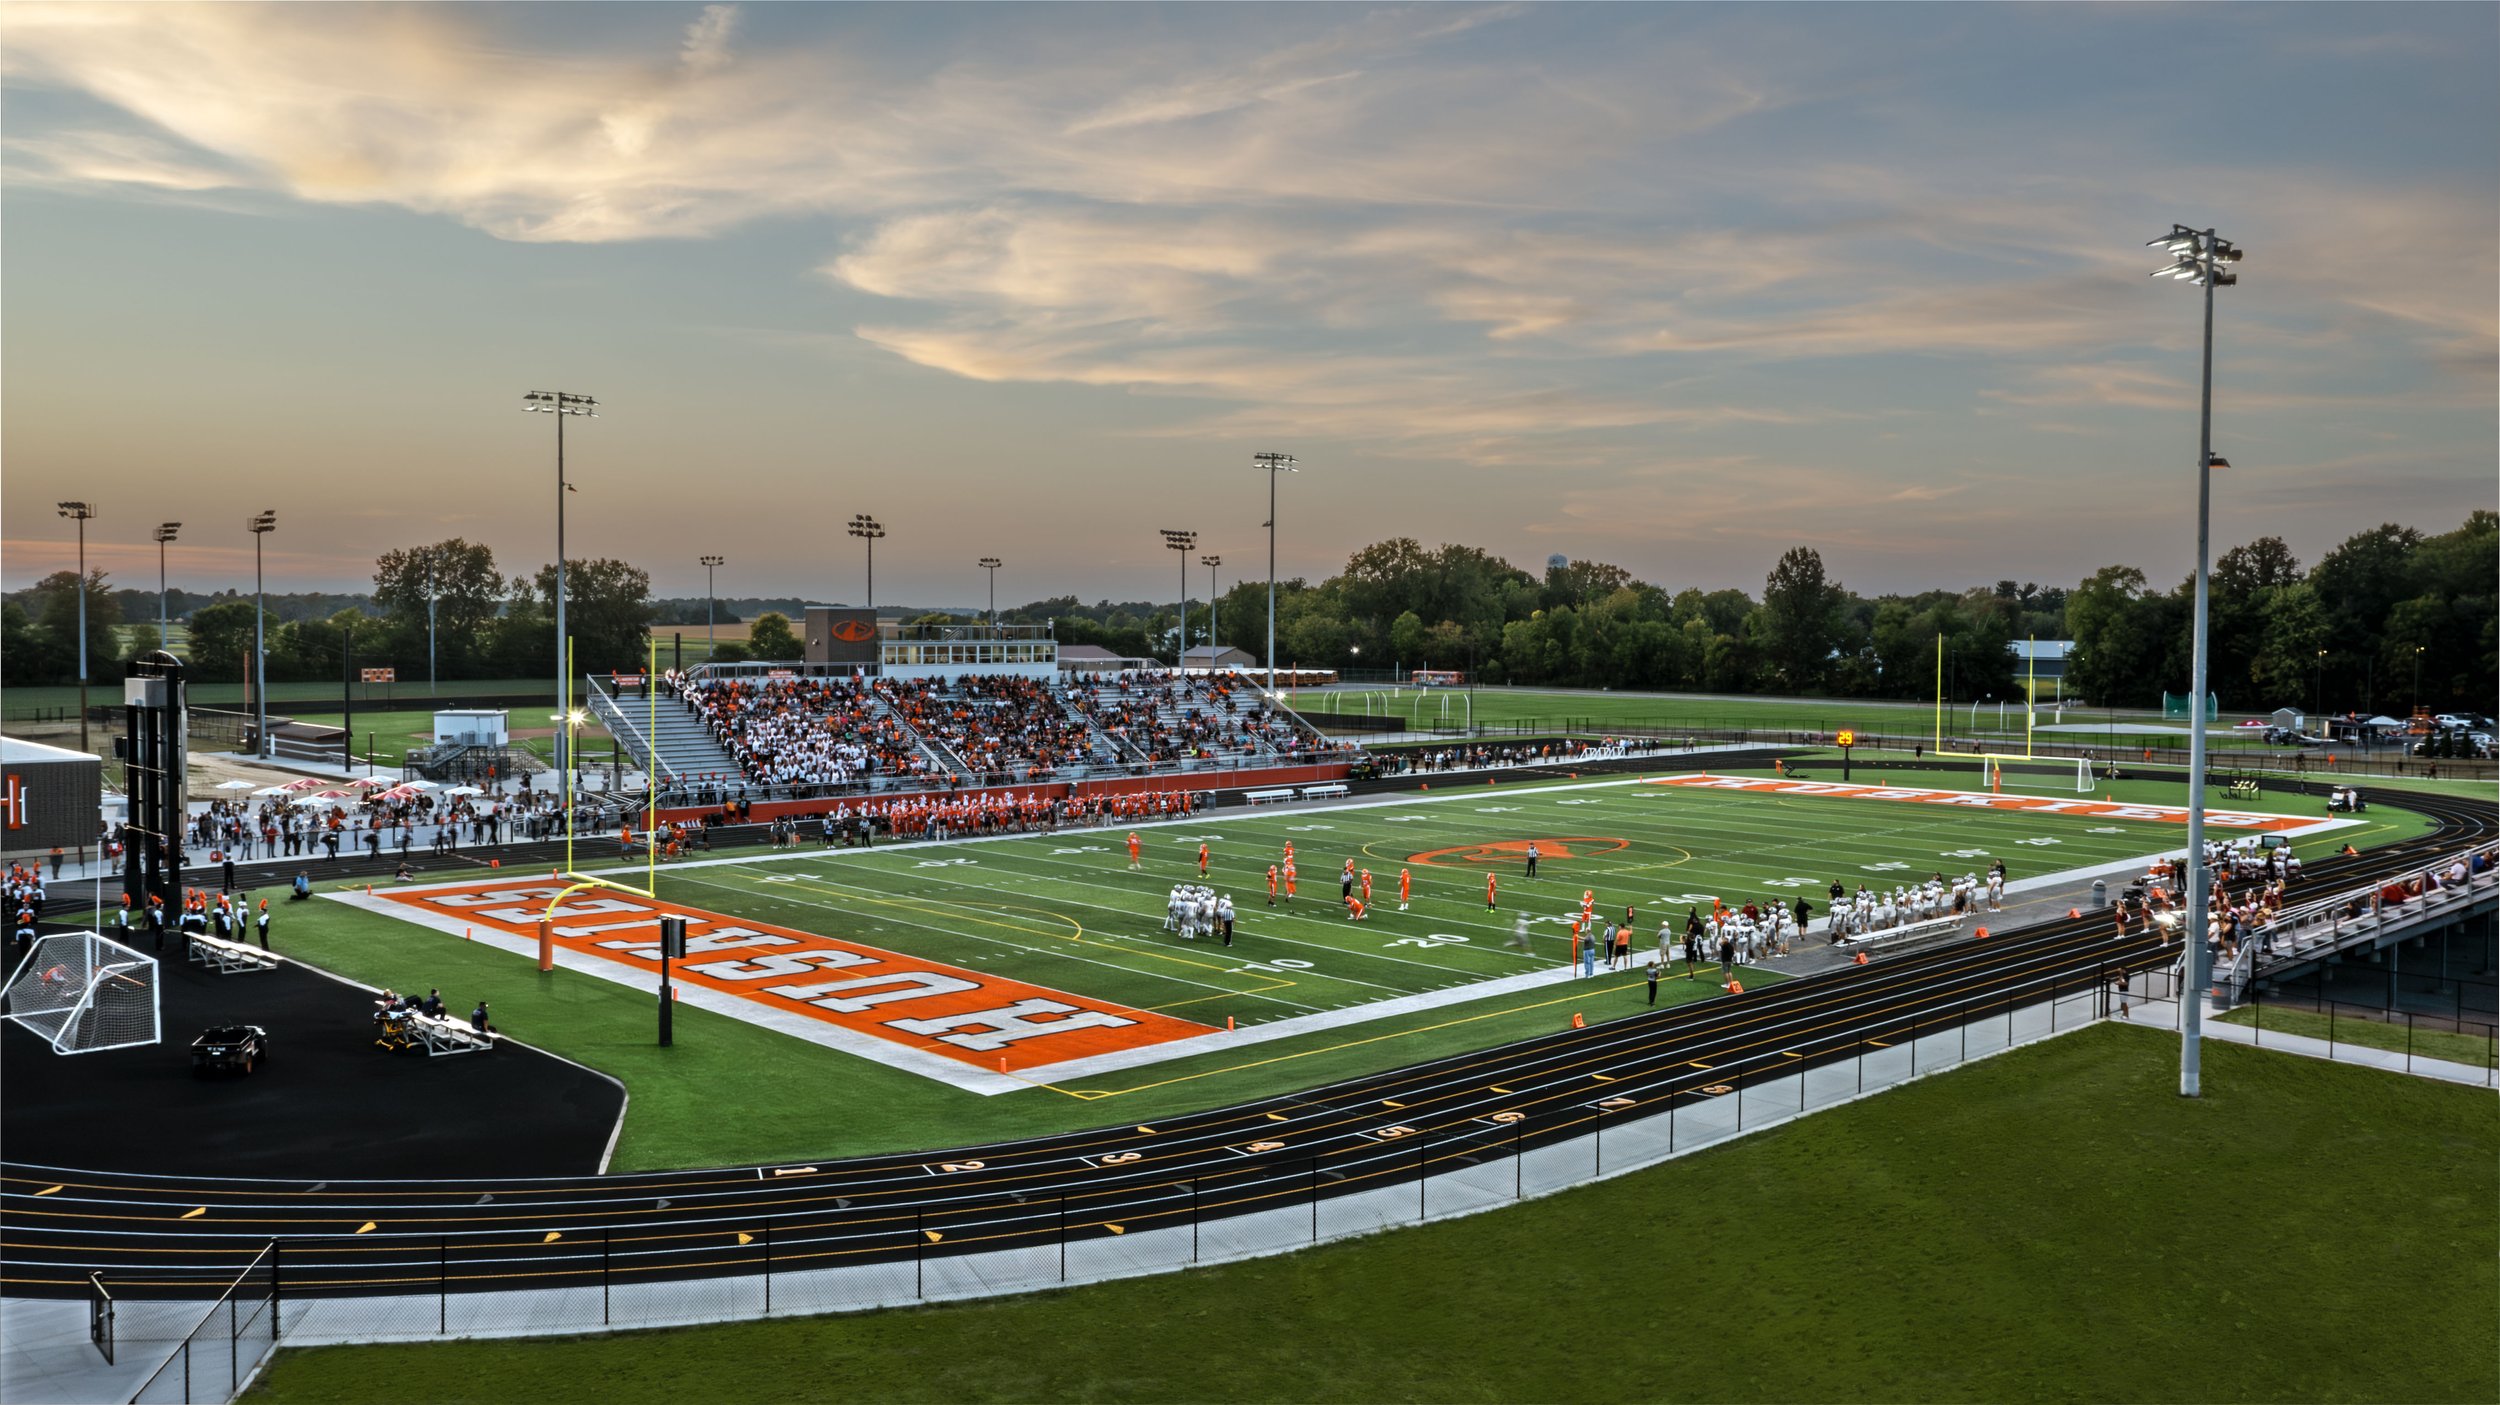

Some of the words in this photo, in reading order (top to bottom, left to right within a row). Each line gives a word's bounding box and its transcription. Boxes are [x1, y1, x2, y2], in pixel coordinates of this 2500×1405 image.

[1838, 730, 1853, 744] 29
[1682, 779, 2277, 826] HUSKIES
[917, 858, 978, 867] 20
[764, 872, 823, 882] 10
[1762, 877, 1821, 887] 50
[1661, 893, 1720, 904] 40
[1535, 912, 1604, 925] 30
[1397, 933, 1470, 948] 20
[421, 886, 1141, 1052] HUSKIES
[1243, 958, 1315, 973] 10
[1599, 1097, 1637, 1107] 7
[1377, 1125, 1416, 1137] 5
[1247, 1141, 1285, 1153] 4
[1101, 1152, 1142, 1164] 3
[775, 1166, 818, 1176] 1
[942, 1161, 985, 1172] 2
